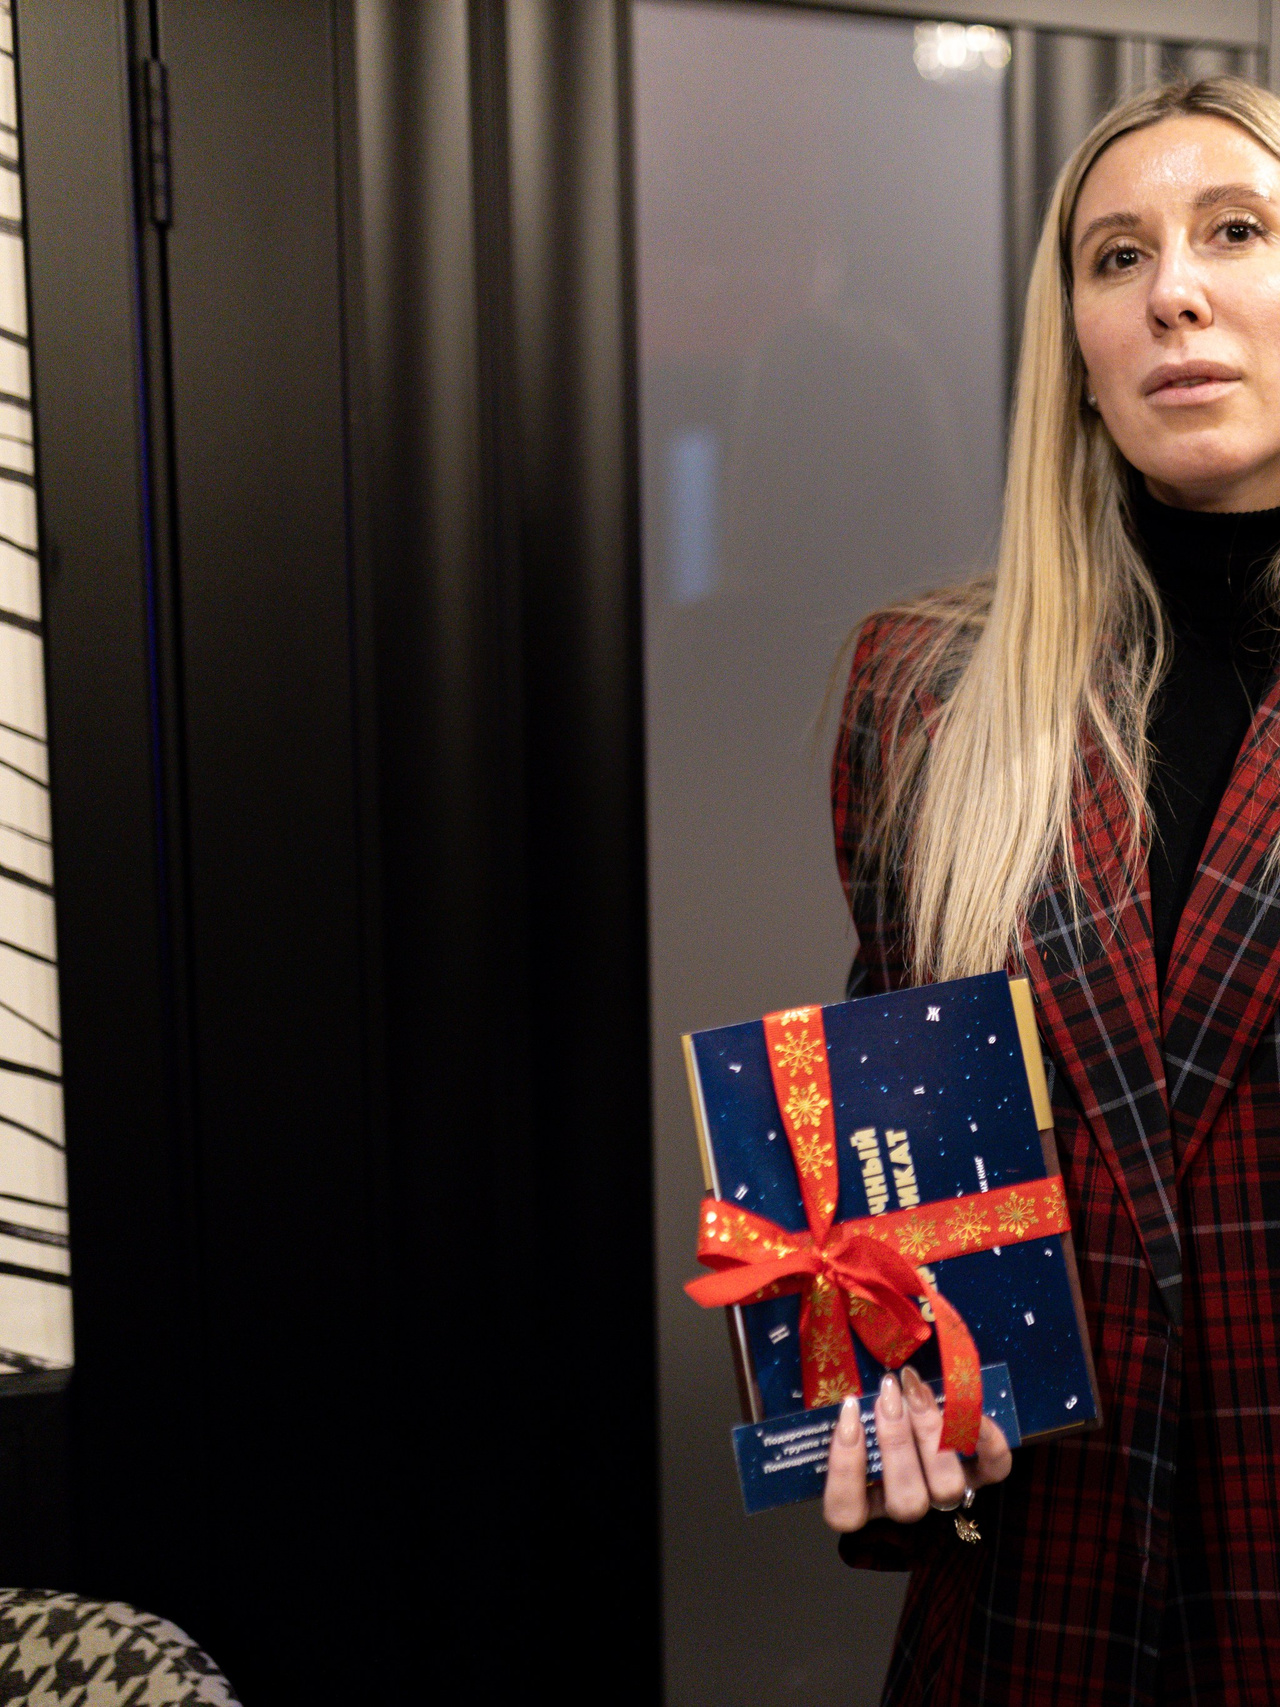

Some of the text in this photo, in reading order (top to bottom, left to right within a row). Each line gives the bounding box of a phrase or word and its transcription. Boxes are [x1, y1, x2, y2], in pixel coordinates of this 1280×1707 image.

[850, 1127, 889, 1217] ЧНЫЙ
[885, 1130, 920, 1210] ИКАТ
[763, 1422, 829, 1447] Подарочный
